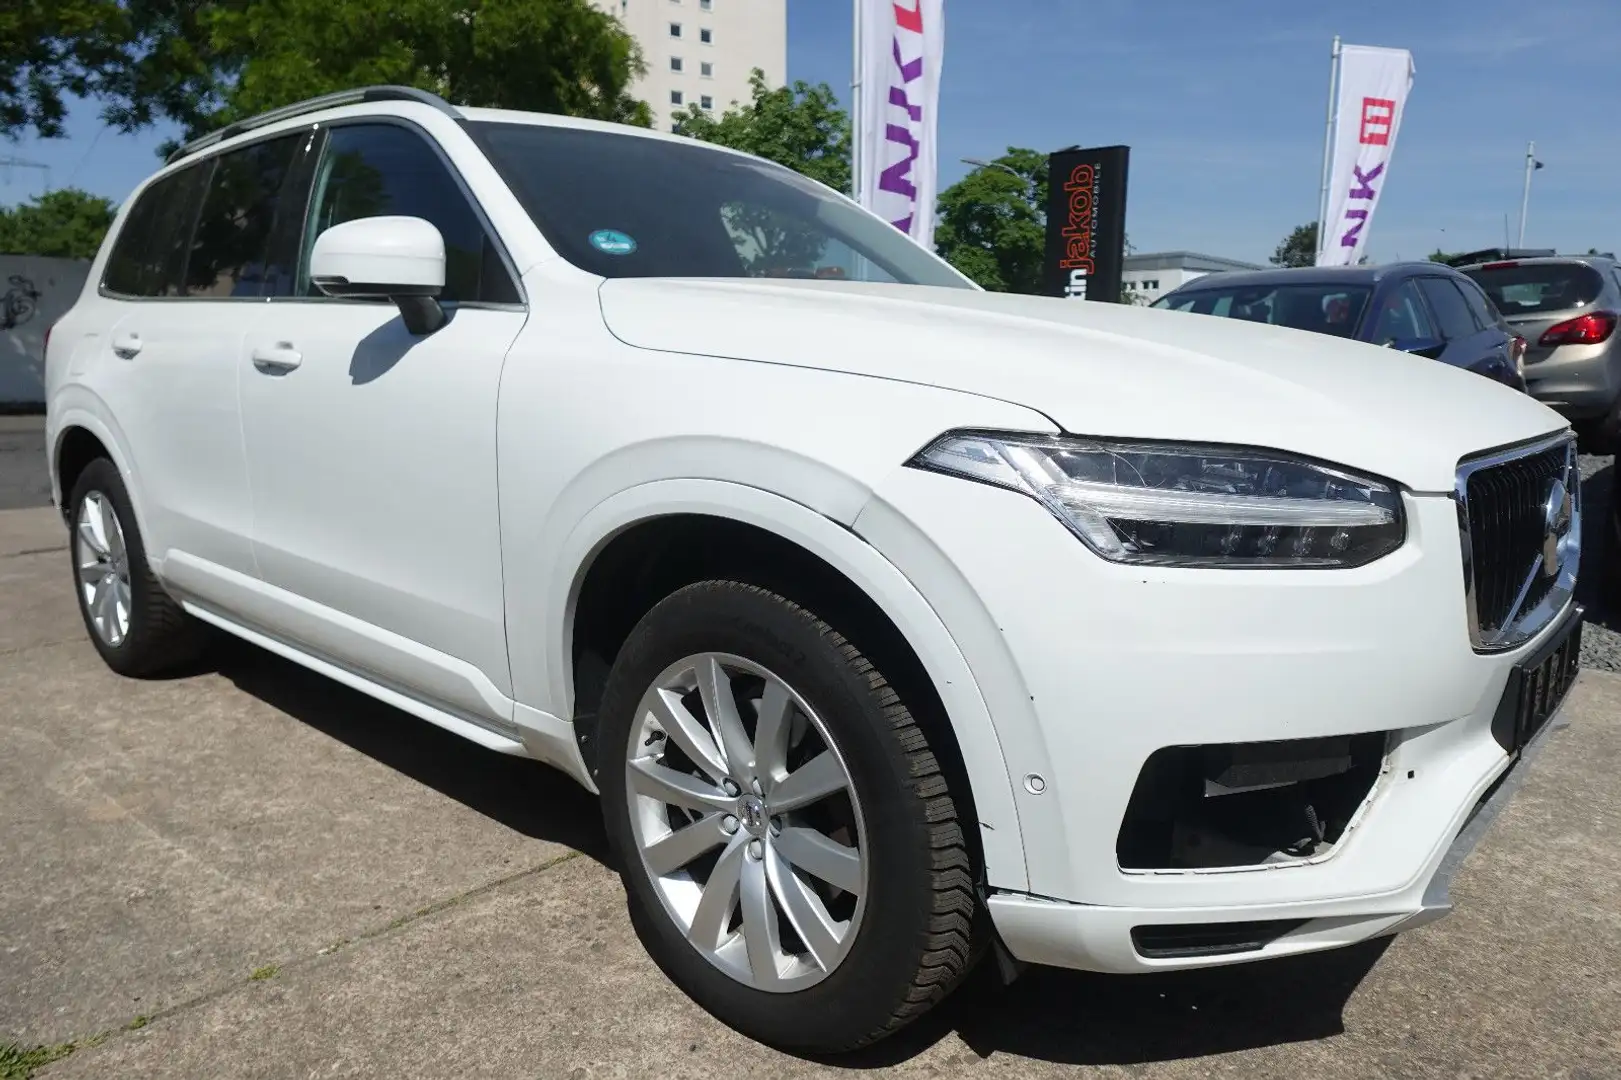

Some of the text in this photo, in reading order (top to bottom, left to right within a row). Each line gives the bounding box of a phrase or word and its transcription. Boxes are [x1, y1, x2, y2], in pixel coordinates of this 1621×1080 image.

[1060, 164, 1094, 275] jakob
[1089, 163, 1102, 258] AUTOMOBILE
[1341, 162, 1384, 262] NK
